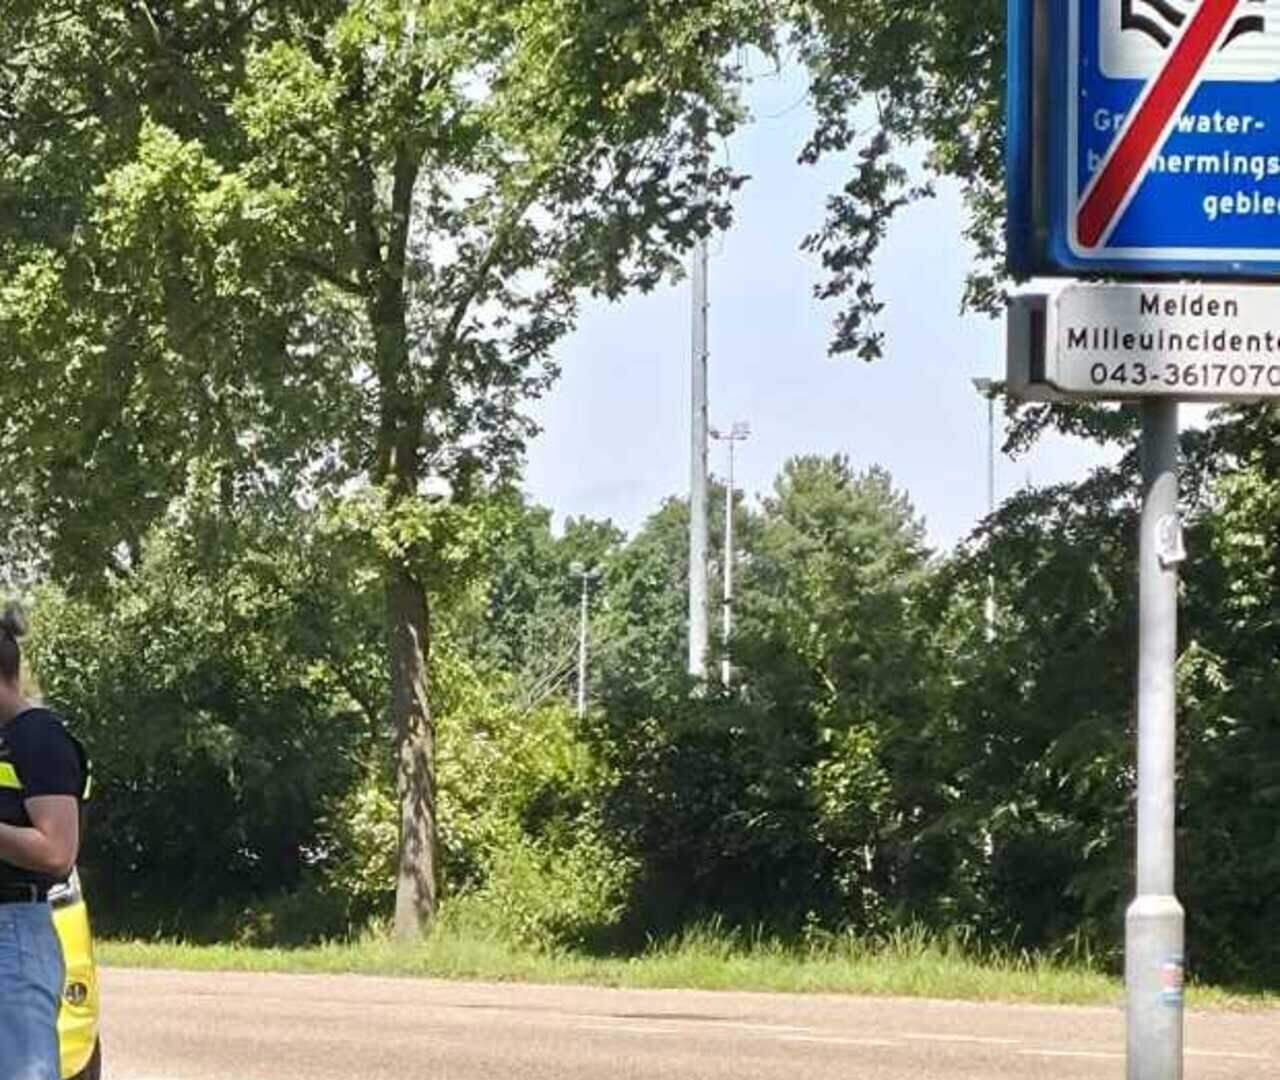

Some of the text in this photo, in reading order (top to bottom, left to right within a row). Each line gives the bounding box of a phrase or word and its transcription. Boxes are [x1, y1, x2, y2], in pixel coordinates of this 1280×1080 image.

[1093, 107, 1266, 133] Grwater-
[1202, 190, 1280, 221] gebie
[1140, 294, 1238, 317] Melden
[1067, 327, 1280, 351] Milieuincident
